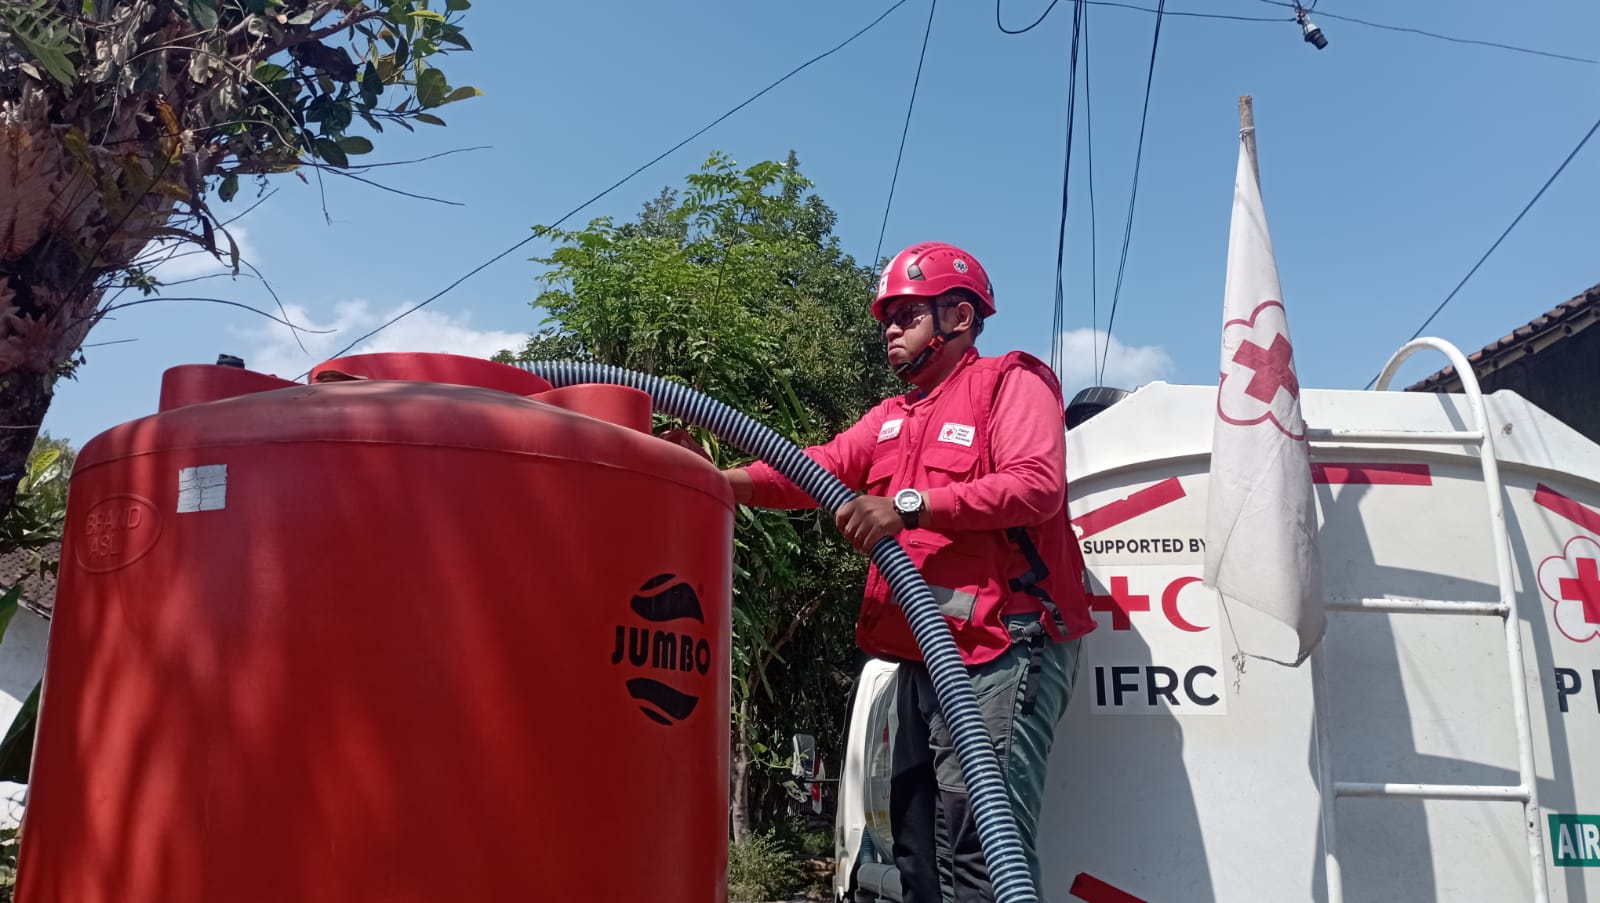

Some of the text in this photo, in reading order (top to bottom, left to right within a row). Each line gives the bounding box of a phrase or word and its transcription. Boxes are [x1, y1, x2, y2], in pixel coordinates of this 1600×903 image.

[1083, 538, 1184, 554] SUPPORTED
[611, 625, 711, 676] JUMBO
[1095, 665, 1220, 706] IFRC
[1558, 823, 1600, 860] AIR
